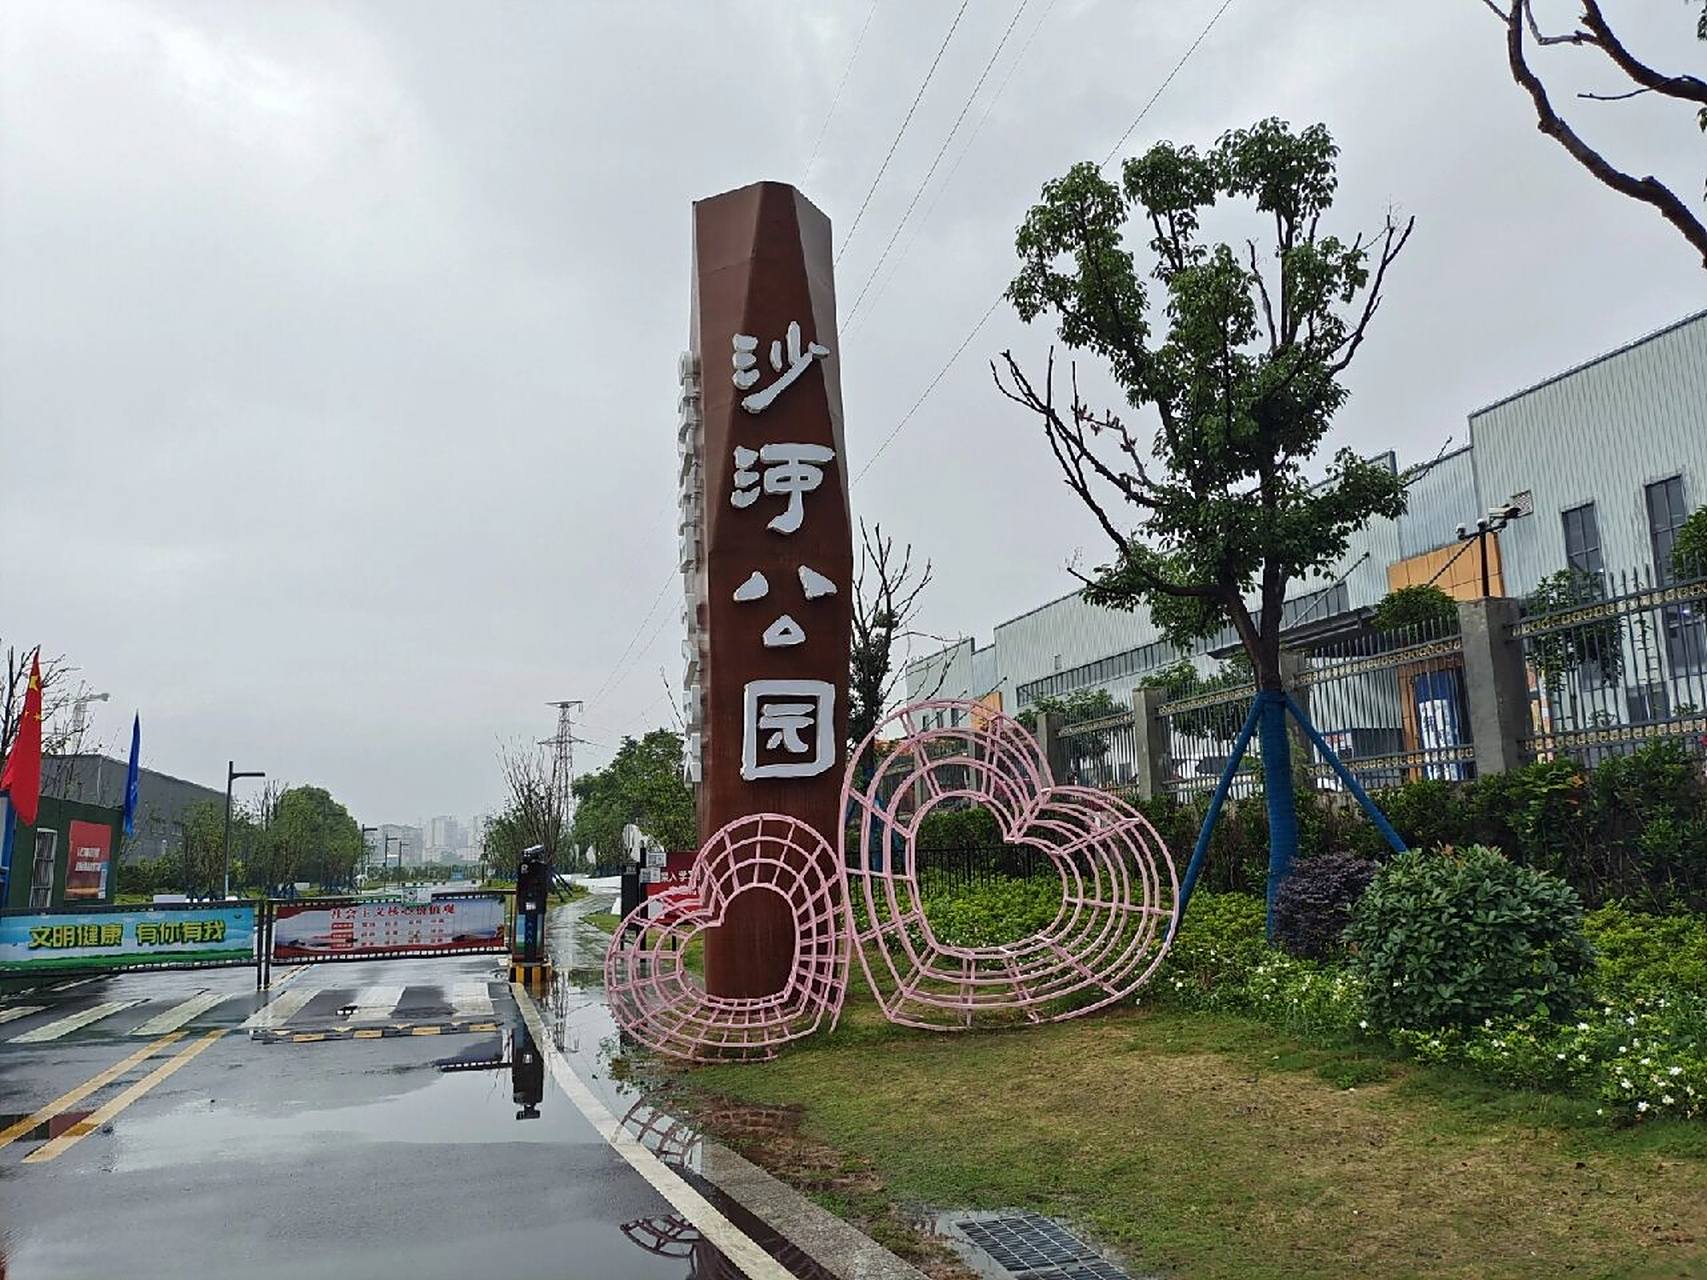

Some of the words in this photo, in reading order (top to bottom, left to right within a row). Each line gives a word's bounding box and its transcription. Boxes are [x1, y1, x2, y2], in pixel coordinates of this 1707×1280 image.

[731, 320, 838, 781] 沙河公园
[28, 923, 123, 949] 文明健康
[136, 919, 226, 945] 有你有我
